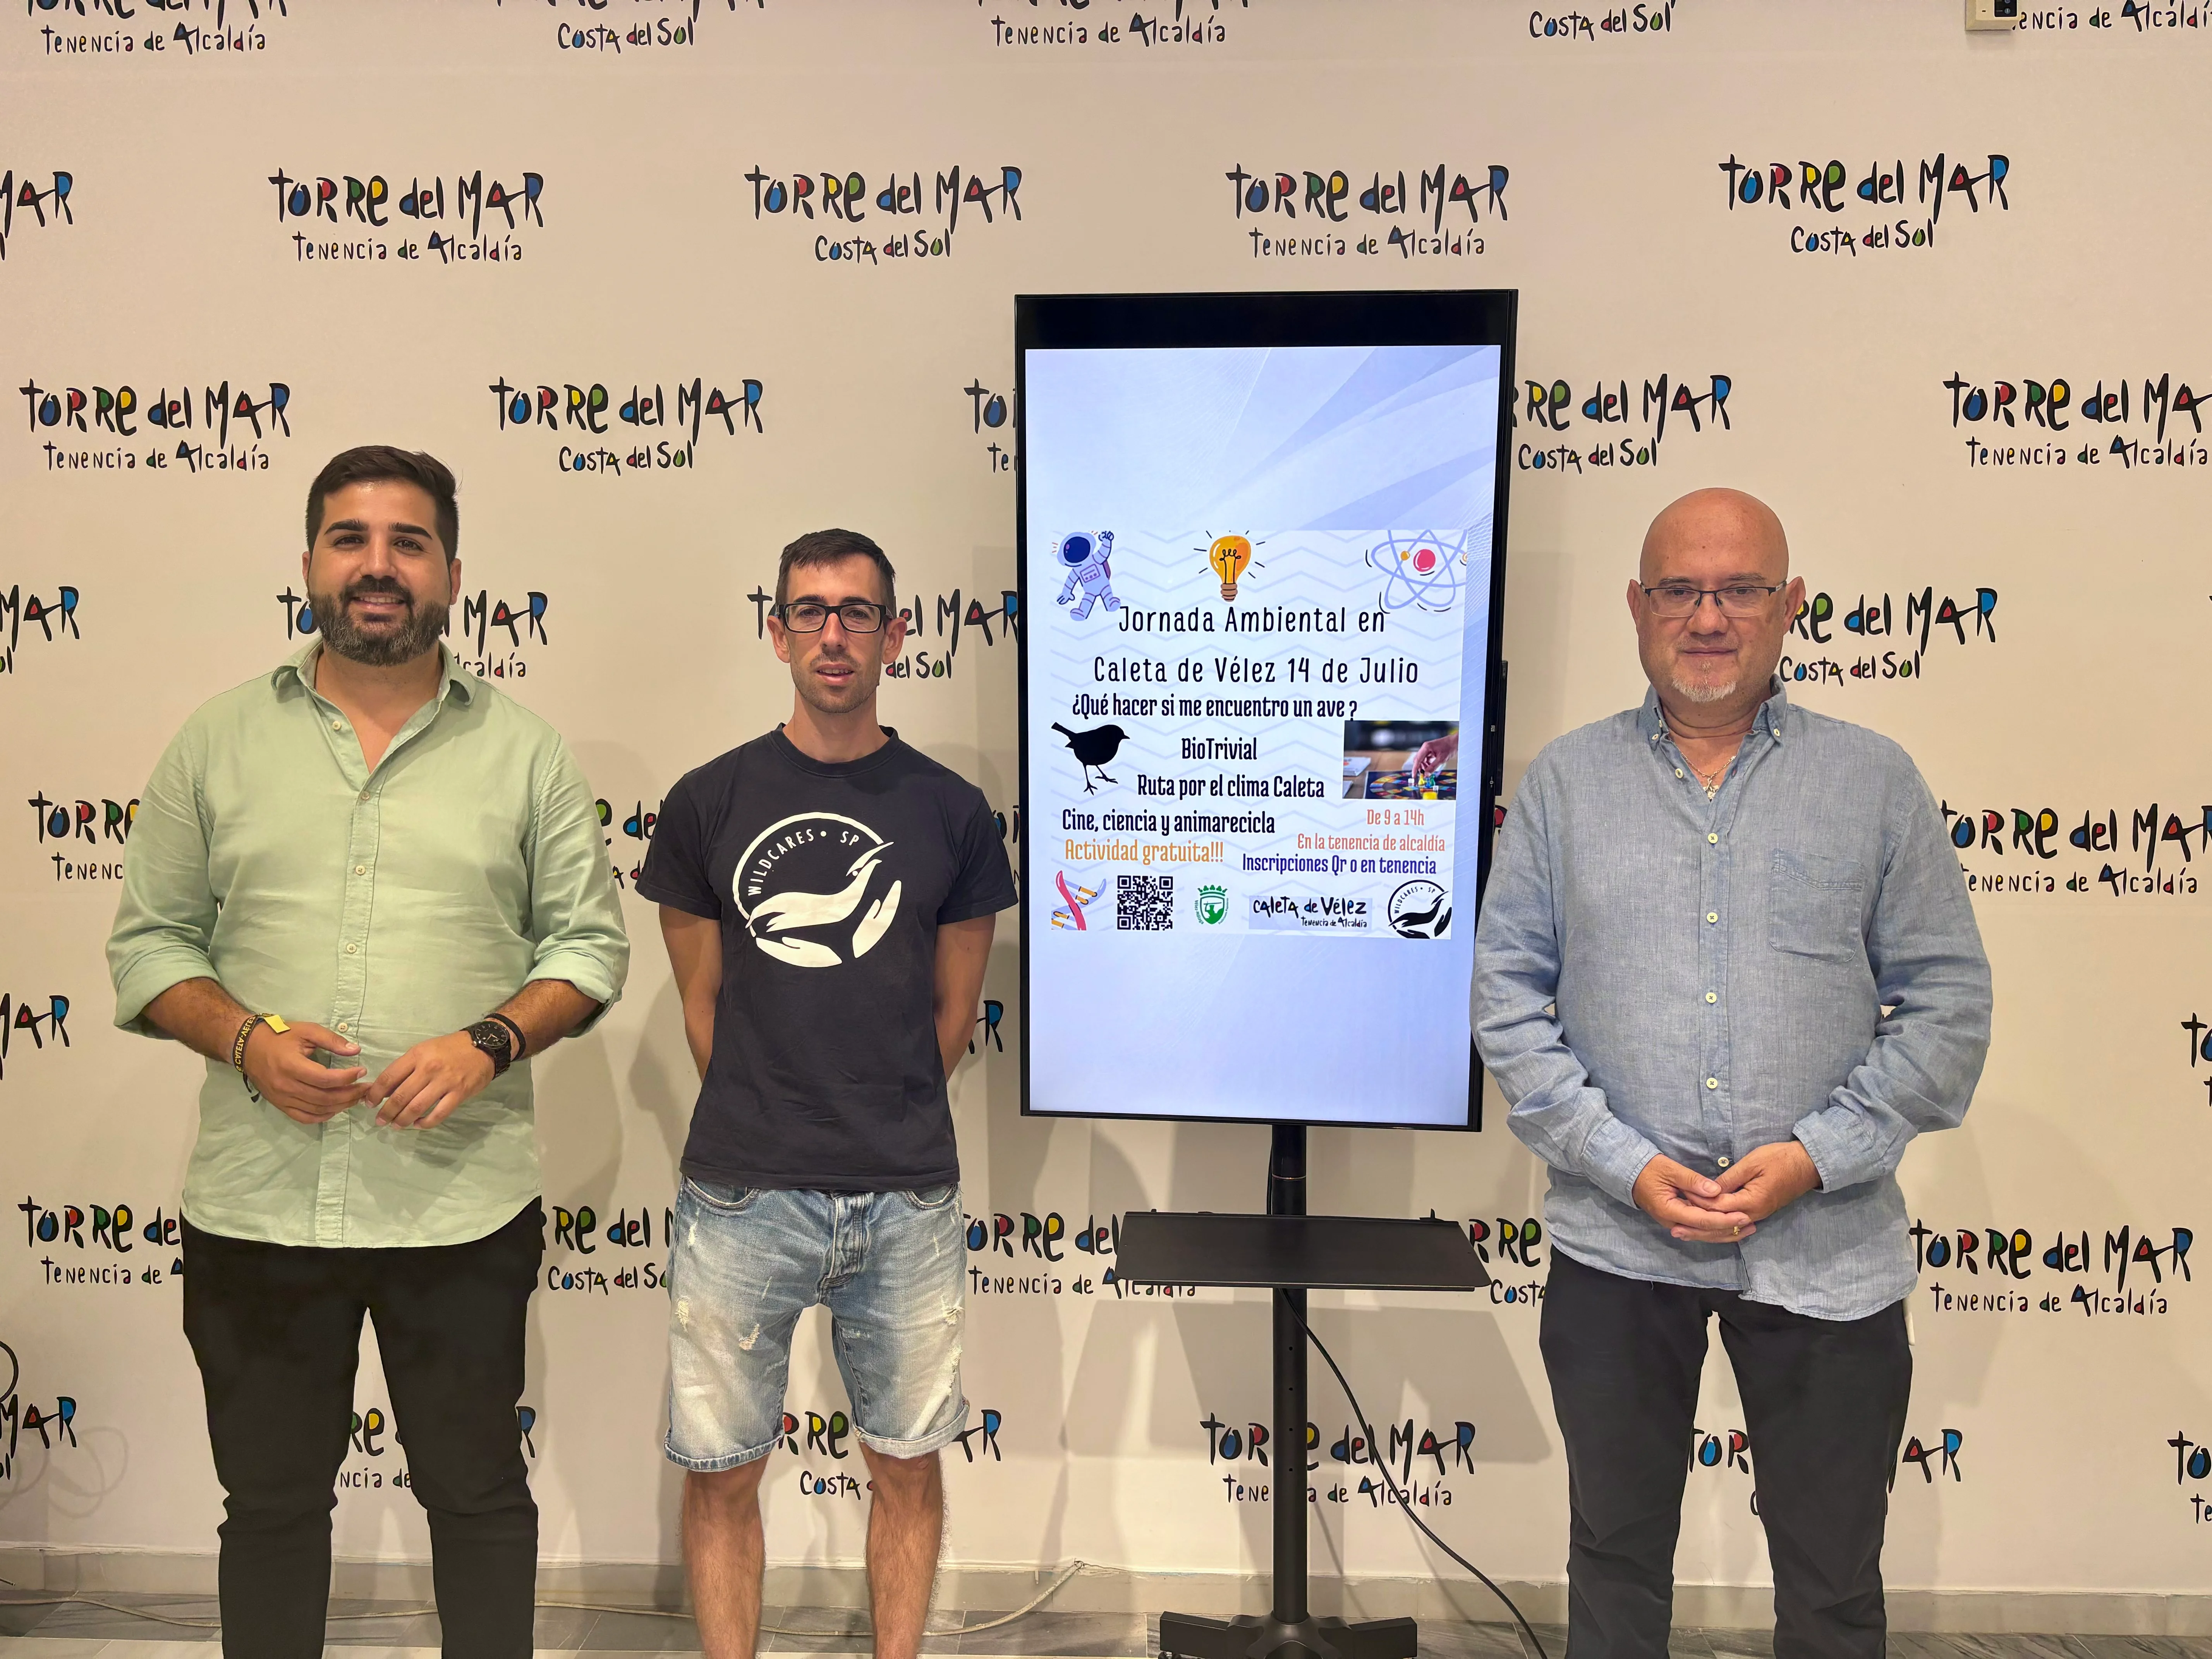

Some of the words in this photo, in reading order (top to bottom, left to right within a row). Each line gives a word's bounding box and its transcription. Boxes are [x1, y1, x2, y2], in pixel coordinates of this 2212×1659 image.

[627, 22, 651, 46] del
[658, 16, 693, 45] Sol
[1601, 9, 1626, 33] del
[2089, 7, 2112, 28] de
[144, 31, 165, 51] de
[1098, 22, 1120, 43] de
[876, 172, 921, 214] del
[936, 166, 1022, 234] MAR
[1360, 171, 1405, 214] del
[1421, 164, 1509, 234] MAR
[1857, 160, 1904, 204] del
[1919, 153, 2009, 225] MAR
[399, 176, 444, 219] del
[459, 170, 543, 240] MAR
[883, 234, 908, 257] del
[914, 228, 950, 257] Sol
[1357, 234, 1378, 255] de
[1863, 224, 1889, 248] del
[1895, 218, 1933, 248] Sol
[398, 239, 419, 259] de
[619, 384, 663, 426] del
[678, 378, 763, 446] MAR
[1582, 380, 1628, 423] del
[1643, 374, 1731, 443] MAR
[2081, 379, 2128, 423] del
[148, 386, 191, 429] del
[206, 381, 290, 452] MAR
[146, 448, 167, 468] de
[627, 445, 651, 468] del
[657, 440, 692, 469] Sol
[1588, 443, 1613, 466] del
[1620, 437, 1656, 466] Sol
[2077, 443, 2100, 464] de
[464, 590, 548, 659] MAR
[1119, 606, 1214, 632] Jornada
[1225, 606, 1345, 632] Ambiental
[1359, 611, 1384, 632] en
[1844, 593, 1891, 636] del
[1907, 587, 1997, 656] MAR
[916, 651, 951, 678] Sol
[1095, 657, 1167, 682] Caleta
[1178, 658, 1202, 682] de
[1215, 656, 1275, 682] Vélez
[1288, 658, 1309, 682] 14
[1322, 658, 1347, 683] de
[1360, 658, 1417, 683] Julio
[1850, 656, 1875, 679] del
[1882, 650, 1920, 679] Sol
[1073, 694, 1108, 720] ¿Qué
[1113, 693, 1157, 716] hacer
[1162, 694, 1174, 716] si
[1179, 700, 1201, 716] me
[1207, 697, 1288, 716] encuentro
[1293, 701, 1312, 717] un
[1317, 701, 1345, 717] ave
[1182, 737, 1257, 759] BioTrivial
[1137, 775, 1175, 795] Ruta
[1179, 780, 1206, 800] por
[1211, 774, 1223, 796] el
[1228, 774, 1269, 797] clima
[1274, 775, 1324, 797] Caleta
[1063, 808, 1098, 832] Cine,
[1103, 809, 1157, 831] ciencia
[1161, 816, 1169, 836] y
[1175, 810, 1275, 833] animarecicla
[1367, 809, 1381, 824] De
[1385, 809, 1390, 824] 9
[1394, 813, 1400, 824] a
[1404, 809, 1424, 825] 14h
[2069, 809, 2117, 852] del
[1066, 839, 1138, 860] Actividad
[1143, 840, 1223, 864] gratuita!!!
[1298, 833, 1311, 849] En
[1315, 833, 1324, 849] la
[1329, 834, 1379, 850] tenencia
[1383, 834, 1396, 850] de
[1400, 835, 1444, 851] alcaldía
[747, 829, 814, 896] WILDCARES
[840, 831, 860, 846] SP
[1243, 854, 1328, 874] Inscripciones
[1332, 855, 1346, 876] Qr
[1351, 860, 1357, 872] o
[1361, 860, 1376, 872] en
[1379, 856, 1436, 874] tenencia
[2066, 872, 2088, 892] de
[1304, 898, 1318, 913] de
[1321, 897, 1366, 916] Vélez
[1395, 886, 1418, 914] WILDCARES
[607, 1207, 650, 1248] del
[2043, 1231, 2089, 1273] del
[2104, 1225, 2193, 1296] MAR
[142, 1265, 162, 1284] de
[614, 1266, 638, 1288] del
[1072, 1274, 1093, 1294] de
[2040, 1292, 2061, 1312] de
[1390, 1419, 1475, 1485] MAR
[1328, 1483, 1348, 1503] de
